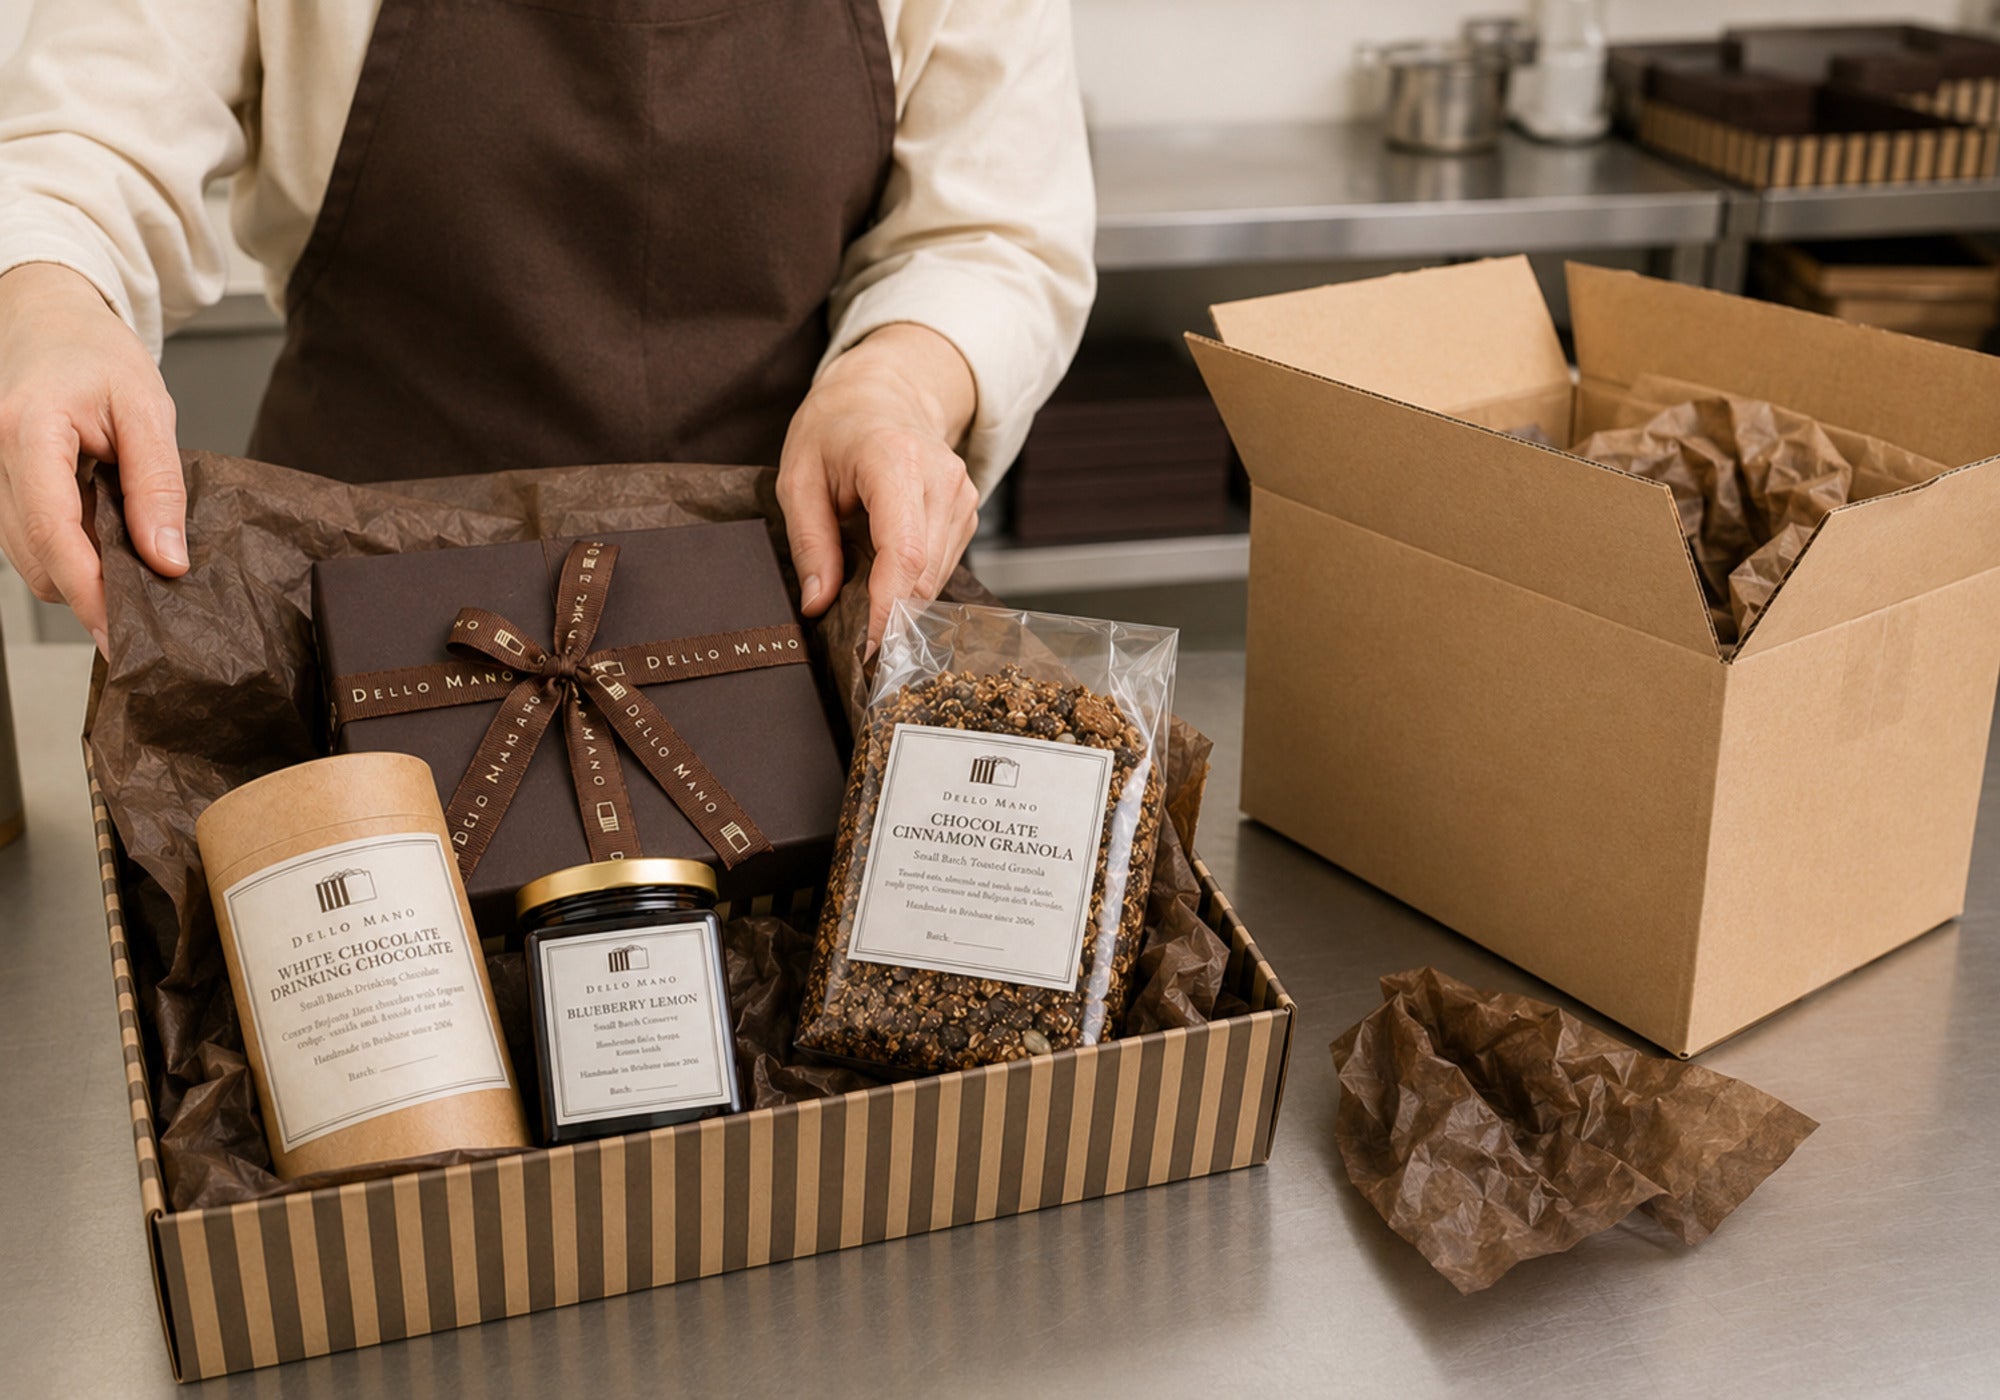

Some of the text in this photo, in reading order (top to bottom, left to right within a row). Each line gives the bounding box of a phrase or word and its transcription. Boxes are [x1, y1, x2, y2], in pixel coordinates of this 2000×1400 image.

[646, 638, 799, 670] DELLO MANO
[352, 670, 514, 703] DELLO MANO
[582, 726, 605, 786] MANO
[626, 704, 718, 813] DELLO MANO
[942, 791, 1038, 812] DELLO MANO
[930, 812, 1039, 838] CHOCOLATE
[892, 824, 1074, 862] CINNAMON GRANOLA
[913, 850, 1046, 878] Small Batch Toasted Granola
[291, 908, 415, 949] DELLO MANO
[278, 927, 441, 981] WHITE CHOCOLATE
[270, 941, 454, 1001] DRINKING CHOCOLATE
[586, 976, 677, 994] DELLO MANO
[300, 993, 326, 1013] Small
[354, 976, 398, 994] Drinking
[567, 993, 698, 1020] BLUEBERRY LEMON
[594, 1022, 616, 1032] Small
